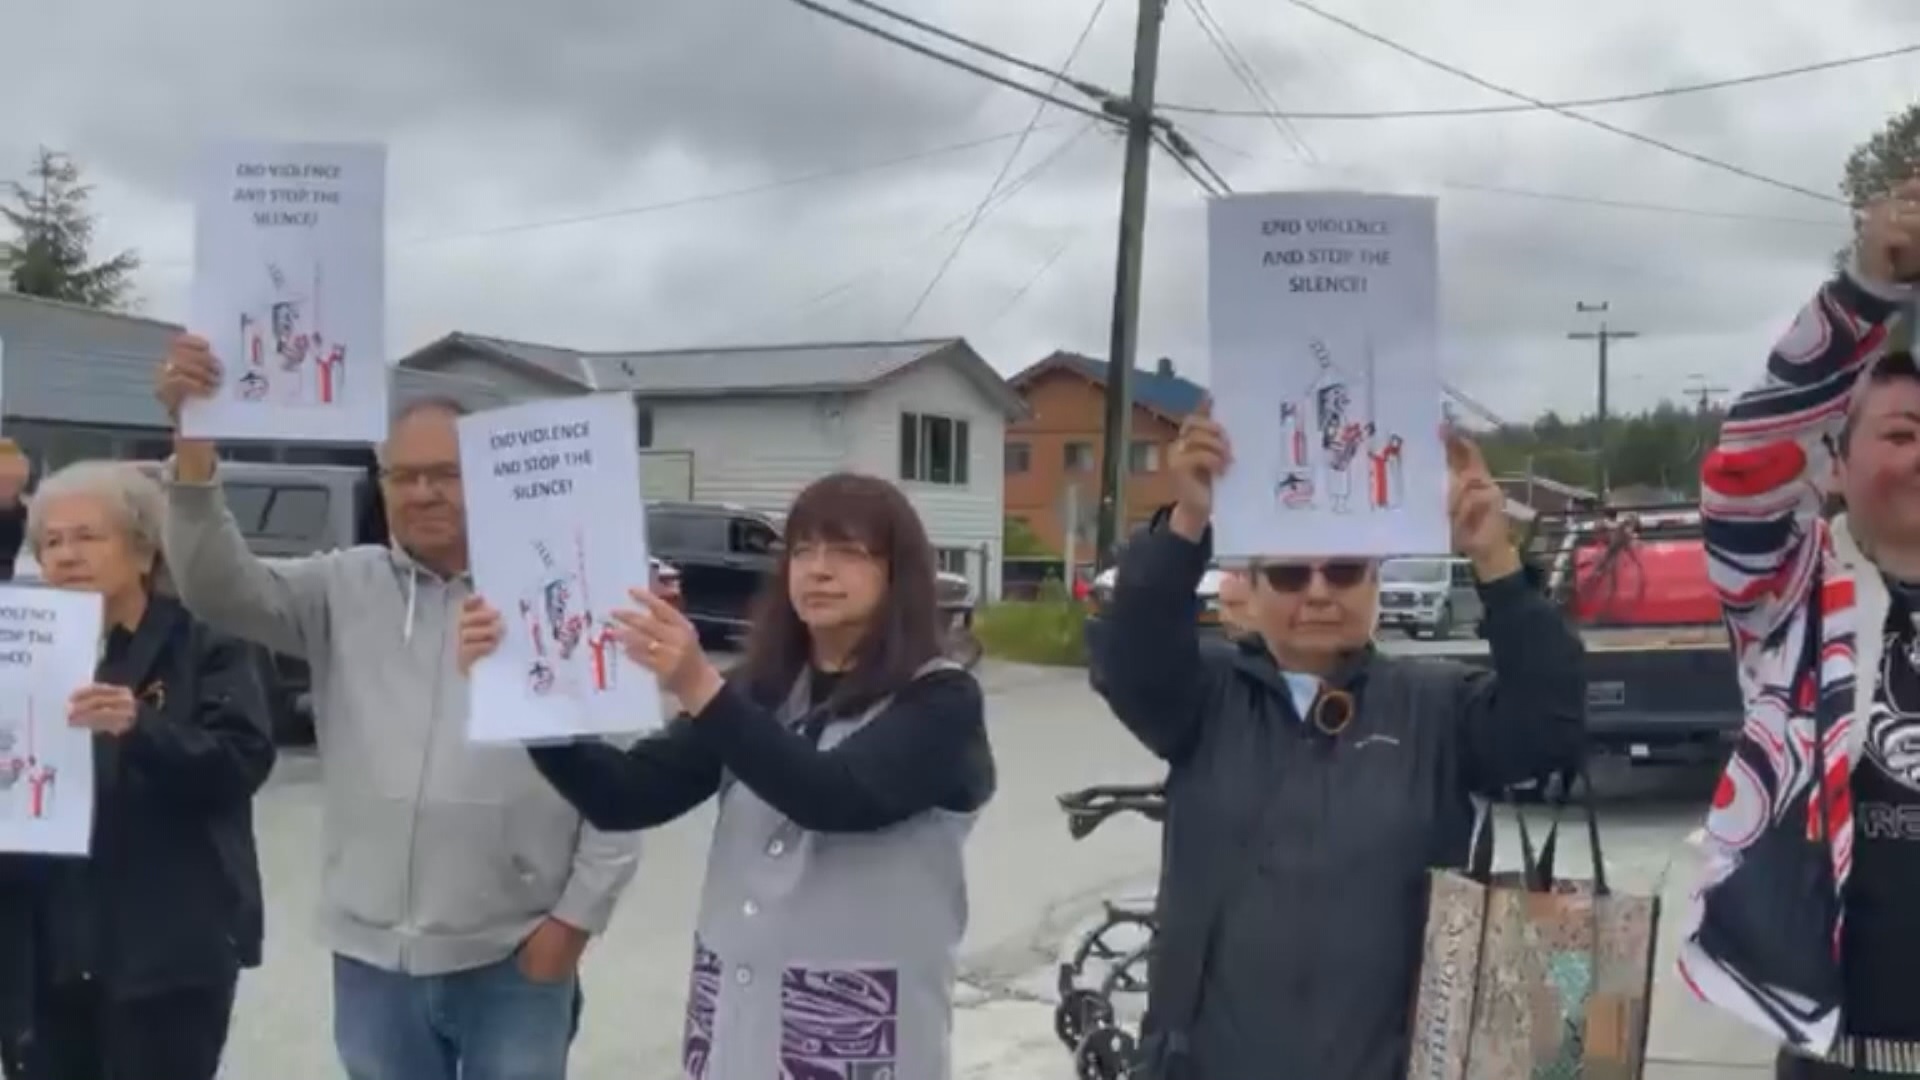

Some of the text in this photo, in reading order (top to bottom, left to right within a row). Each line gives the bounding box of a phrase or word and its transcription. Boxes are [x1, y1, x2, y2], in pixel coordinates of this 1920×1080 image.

[1261, 218, 1390, 236] END VIOLENCE
[1262, 249, 1392, 267] AND STOP THE
[1289, 276, 1368, 293] SILENCE!
[518, 420, 591, 446] VIOLENCE
[493, 449, 592, 477] AND STOP THE
[512, 479, 573, 501] SILENCE!
